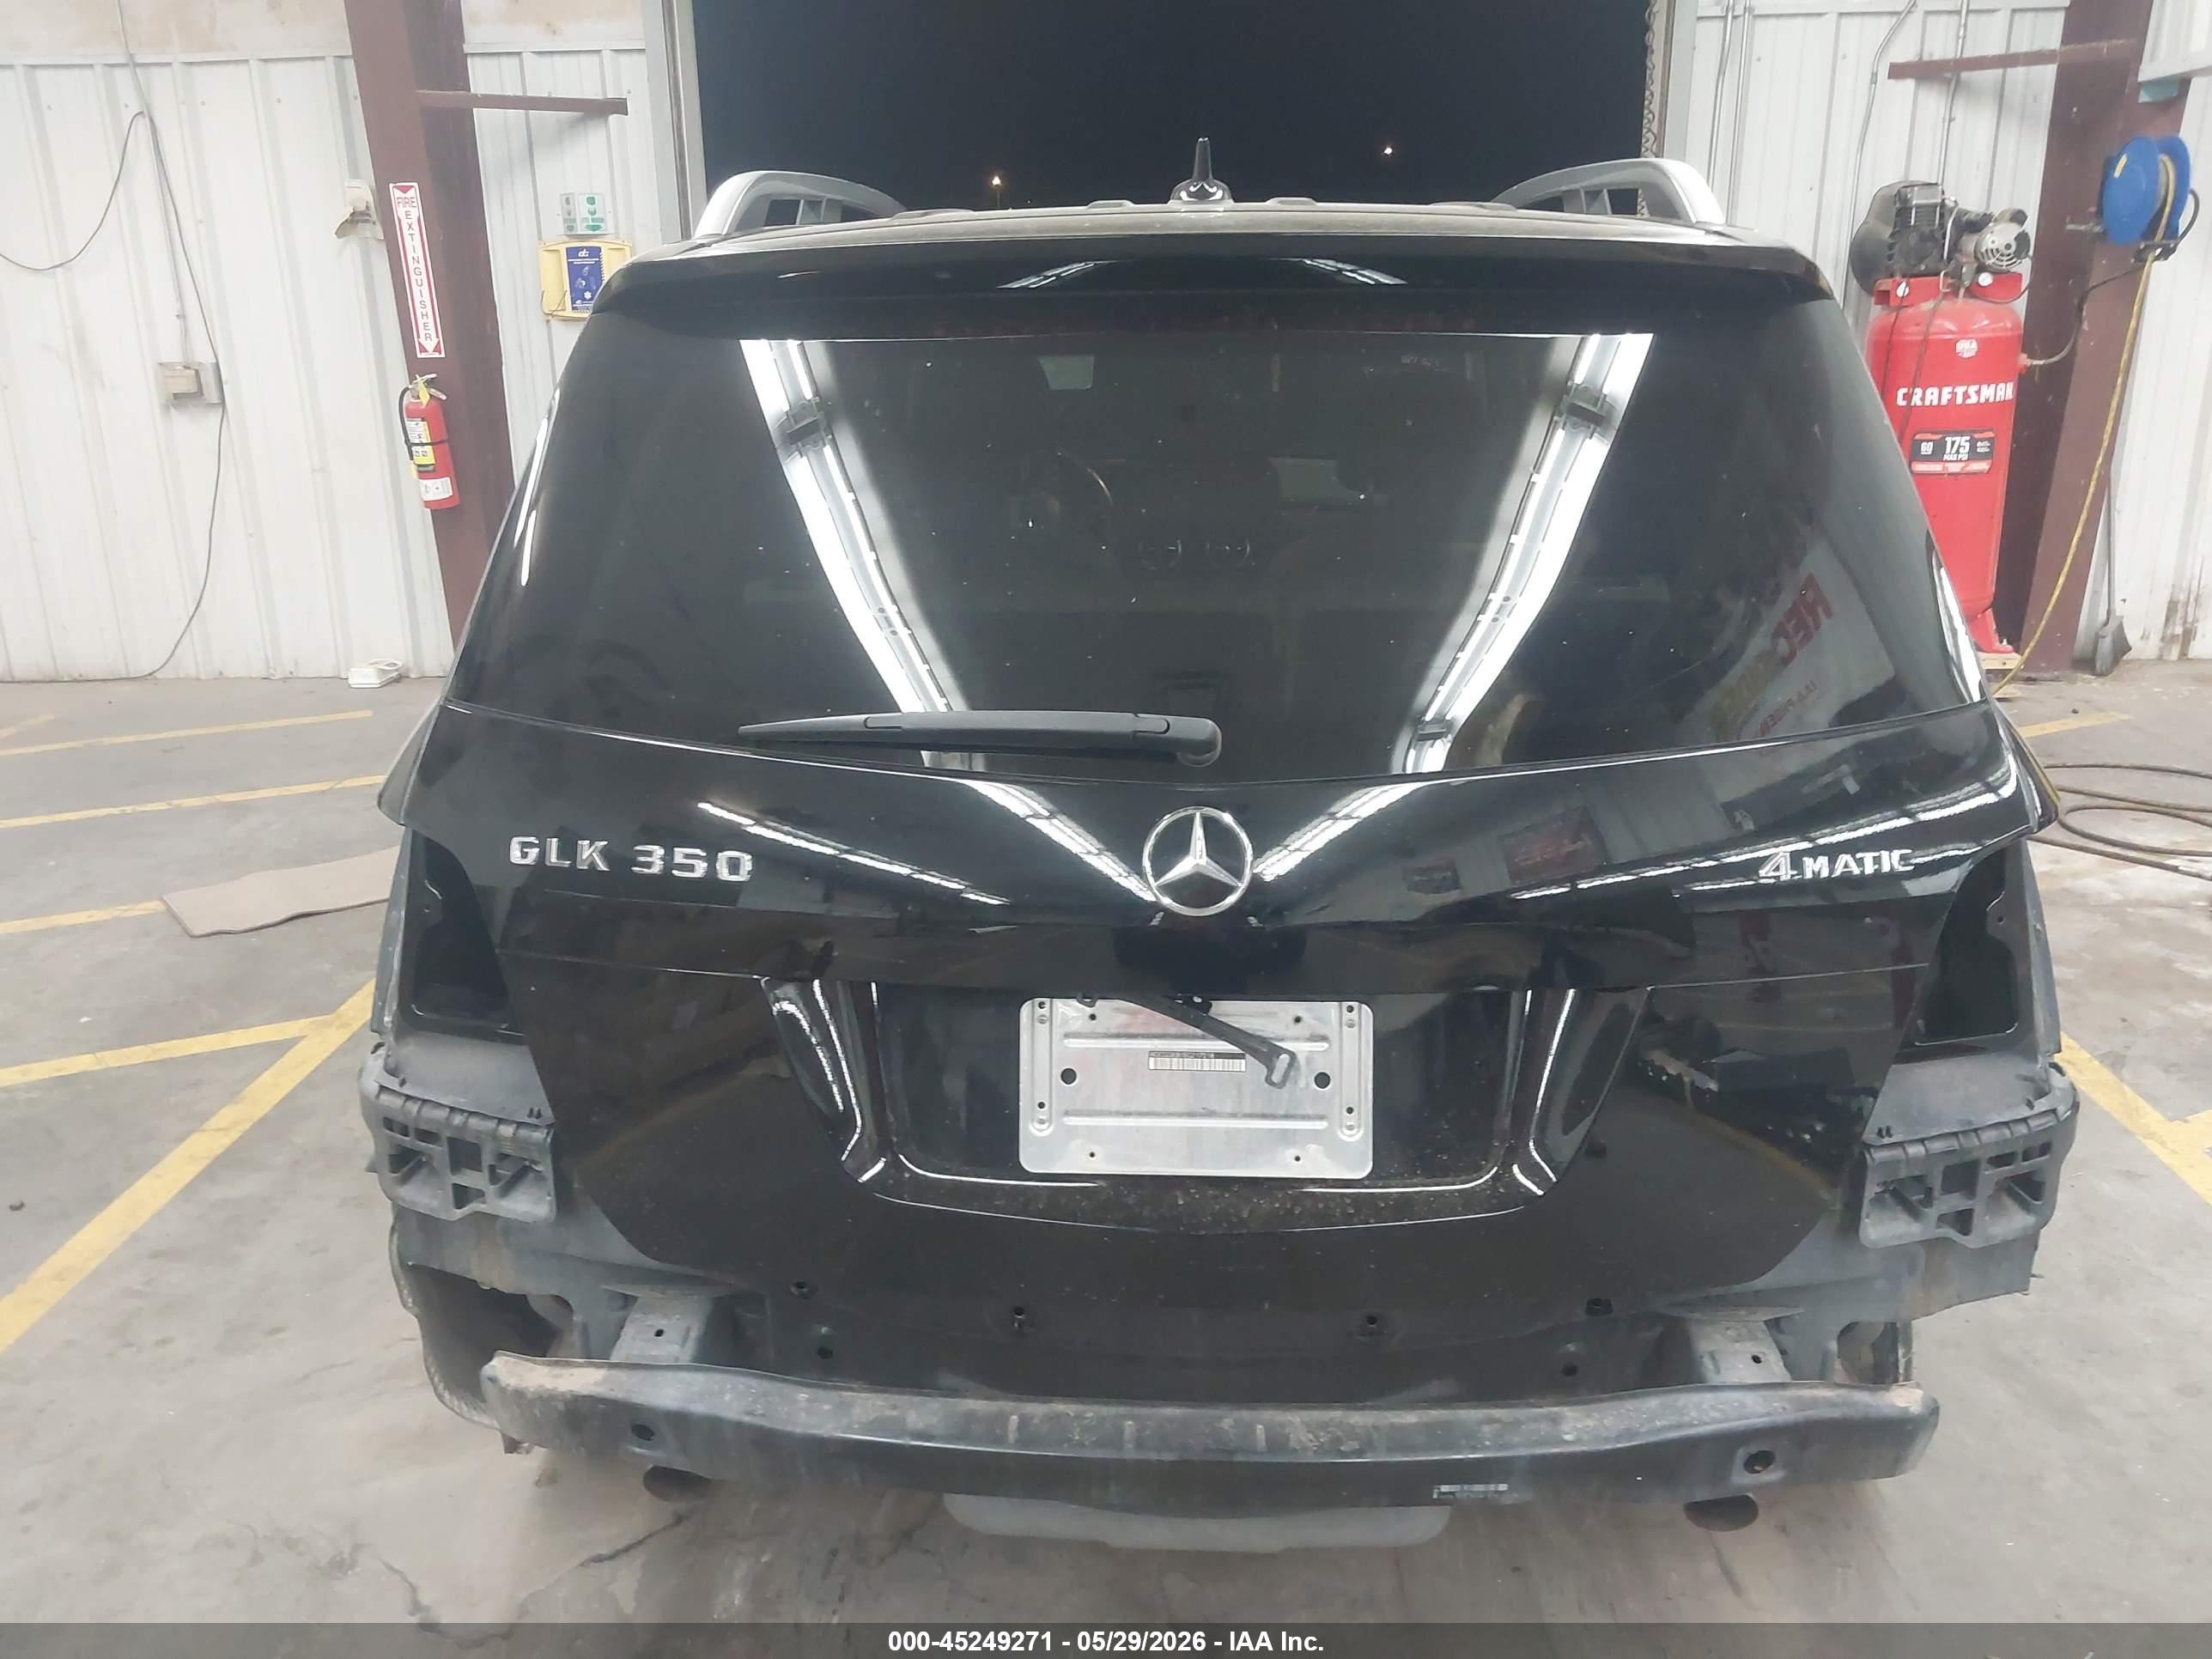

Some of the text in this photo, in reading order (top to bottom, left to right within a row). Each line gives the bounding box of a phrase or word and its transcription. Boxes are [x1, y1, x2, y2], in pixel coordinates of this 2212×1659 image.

[397, 197, 416, 208] FIRE
[404, 210, 433, 342] EXTINGUISHER
[1896, 382, 2014, 406] CRAFTSMAN
[1944, 436, 1971, 453] 175
[510, 836, 754, 882] GLK 350
